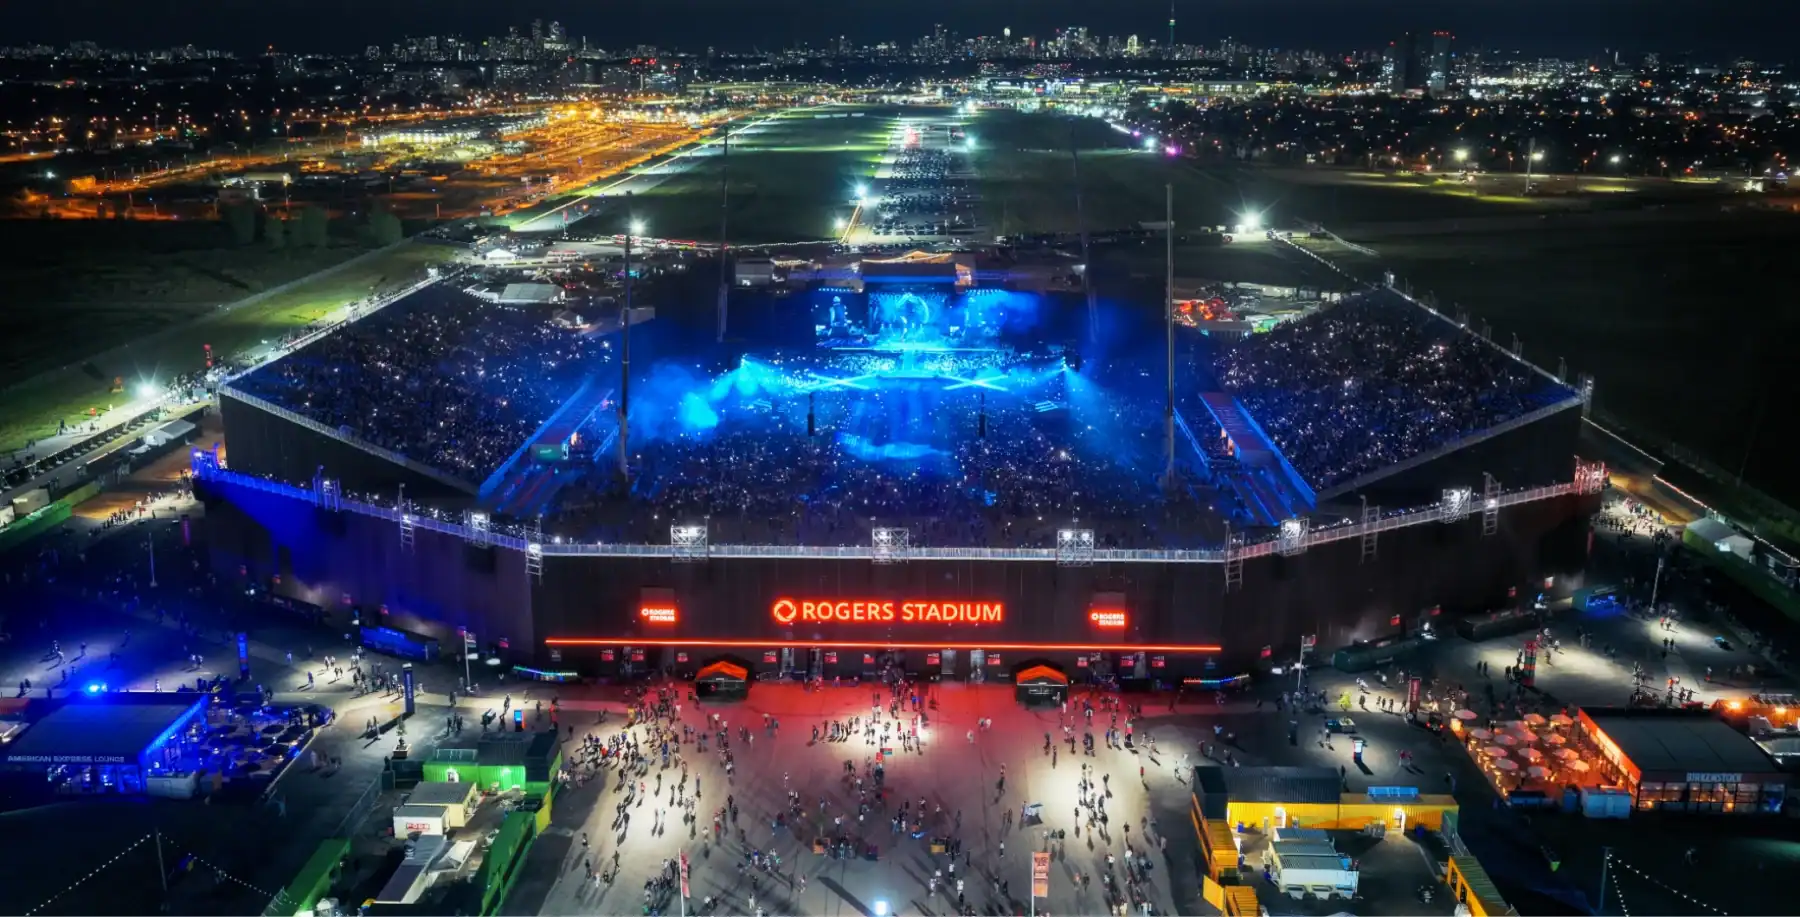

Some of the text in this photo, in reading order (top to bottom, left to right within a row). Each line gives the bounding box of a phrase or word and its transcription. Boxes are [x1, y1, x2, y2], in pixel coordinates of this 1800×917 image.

[803, 602, 1001, 621] ROGERS STADIUM
[1686, 772, 1742, 783] BIRKENSTOCK
